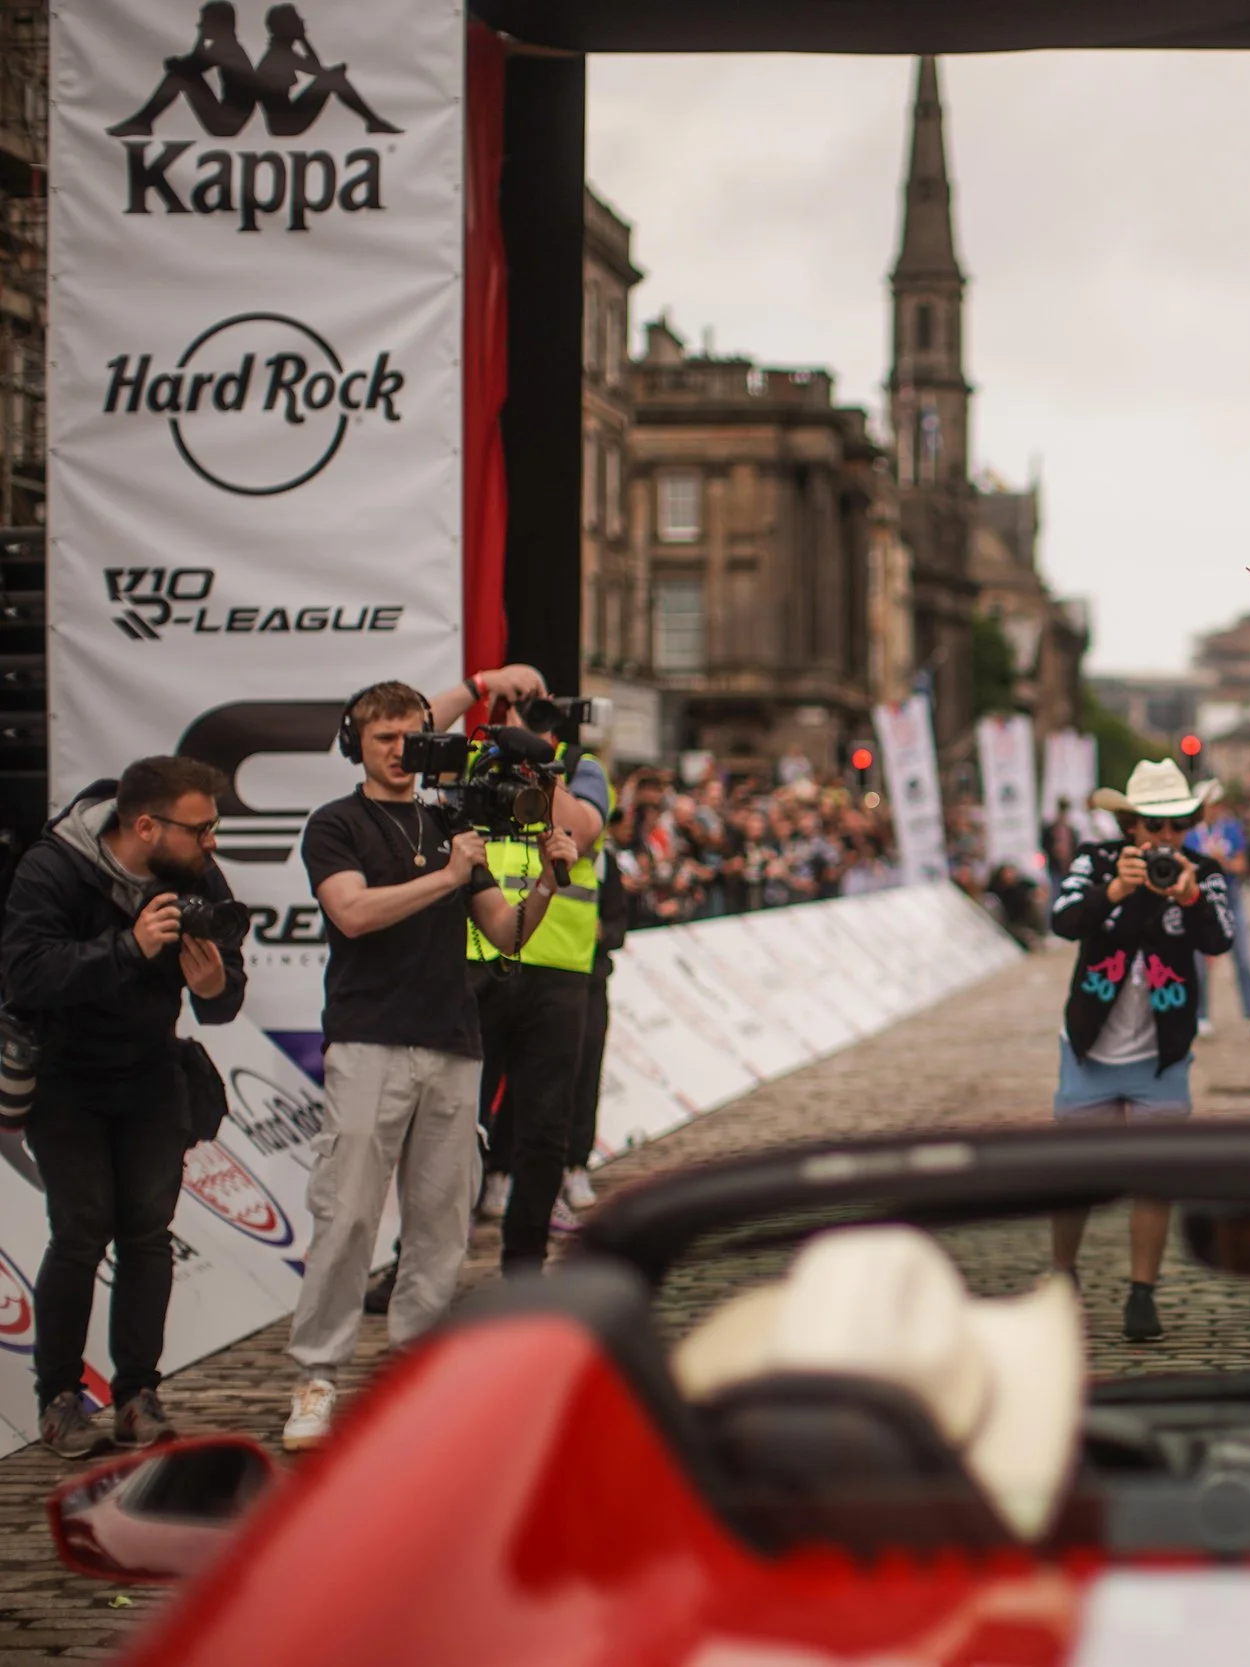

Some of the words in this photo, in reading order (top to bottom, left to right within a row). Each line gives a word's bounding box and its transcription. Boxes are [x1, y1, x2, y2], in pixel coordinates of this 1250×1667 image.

[122, 141, 384, 232] Kappa
[103, 353, 254, 414] Hard
[264, 352, 405, 424] Rock
